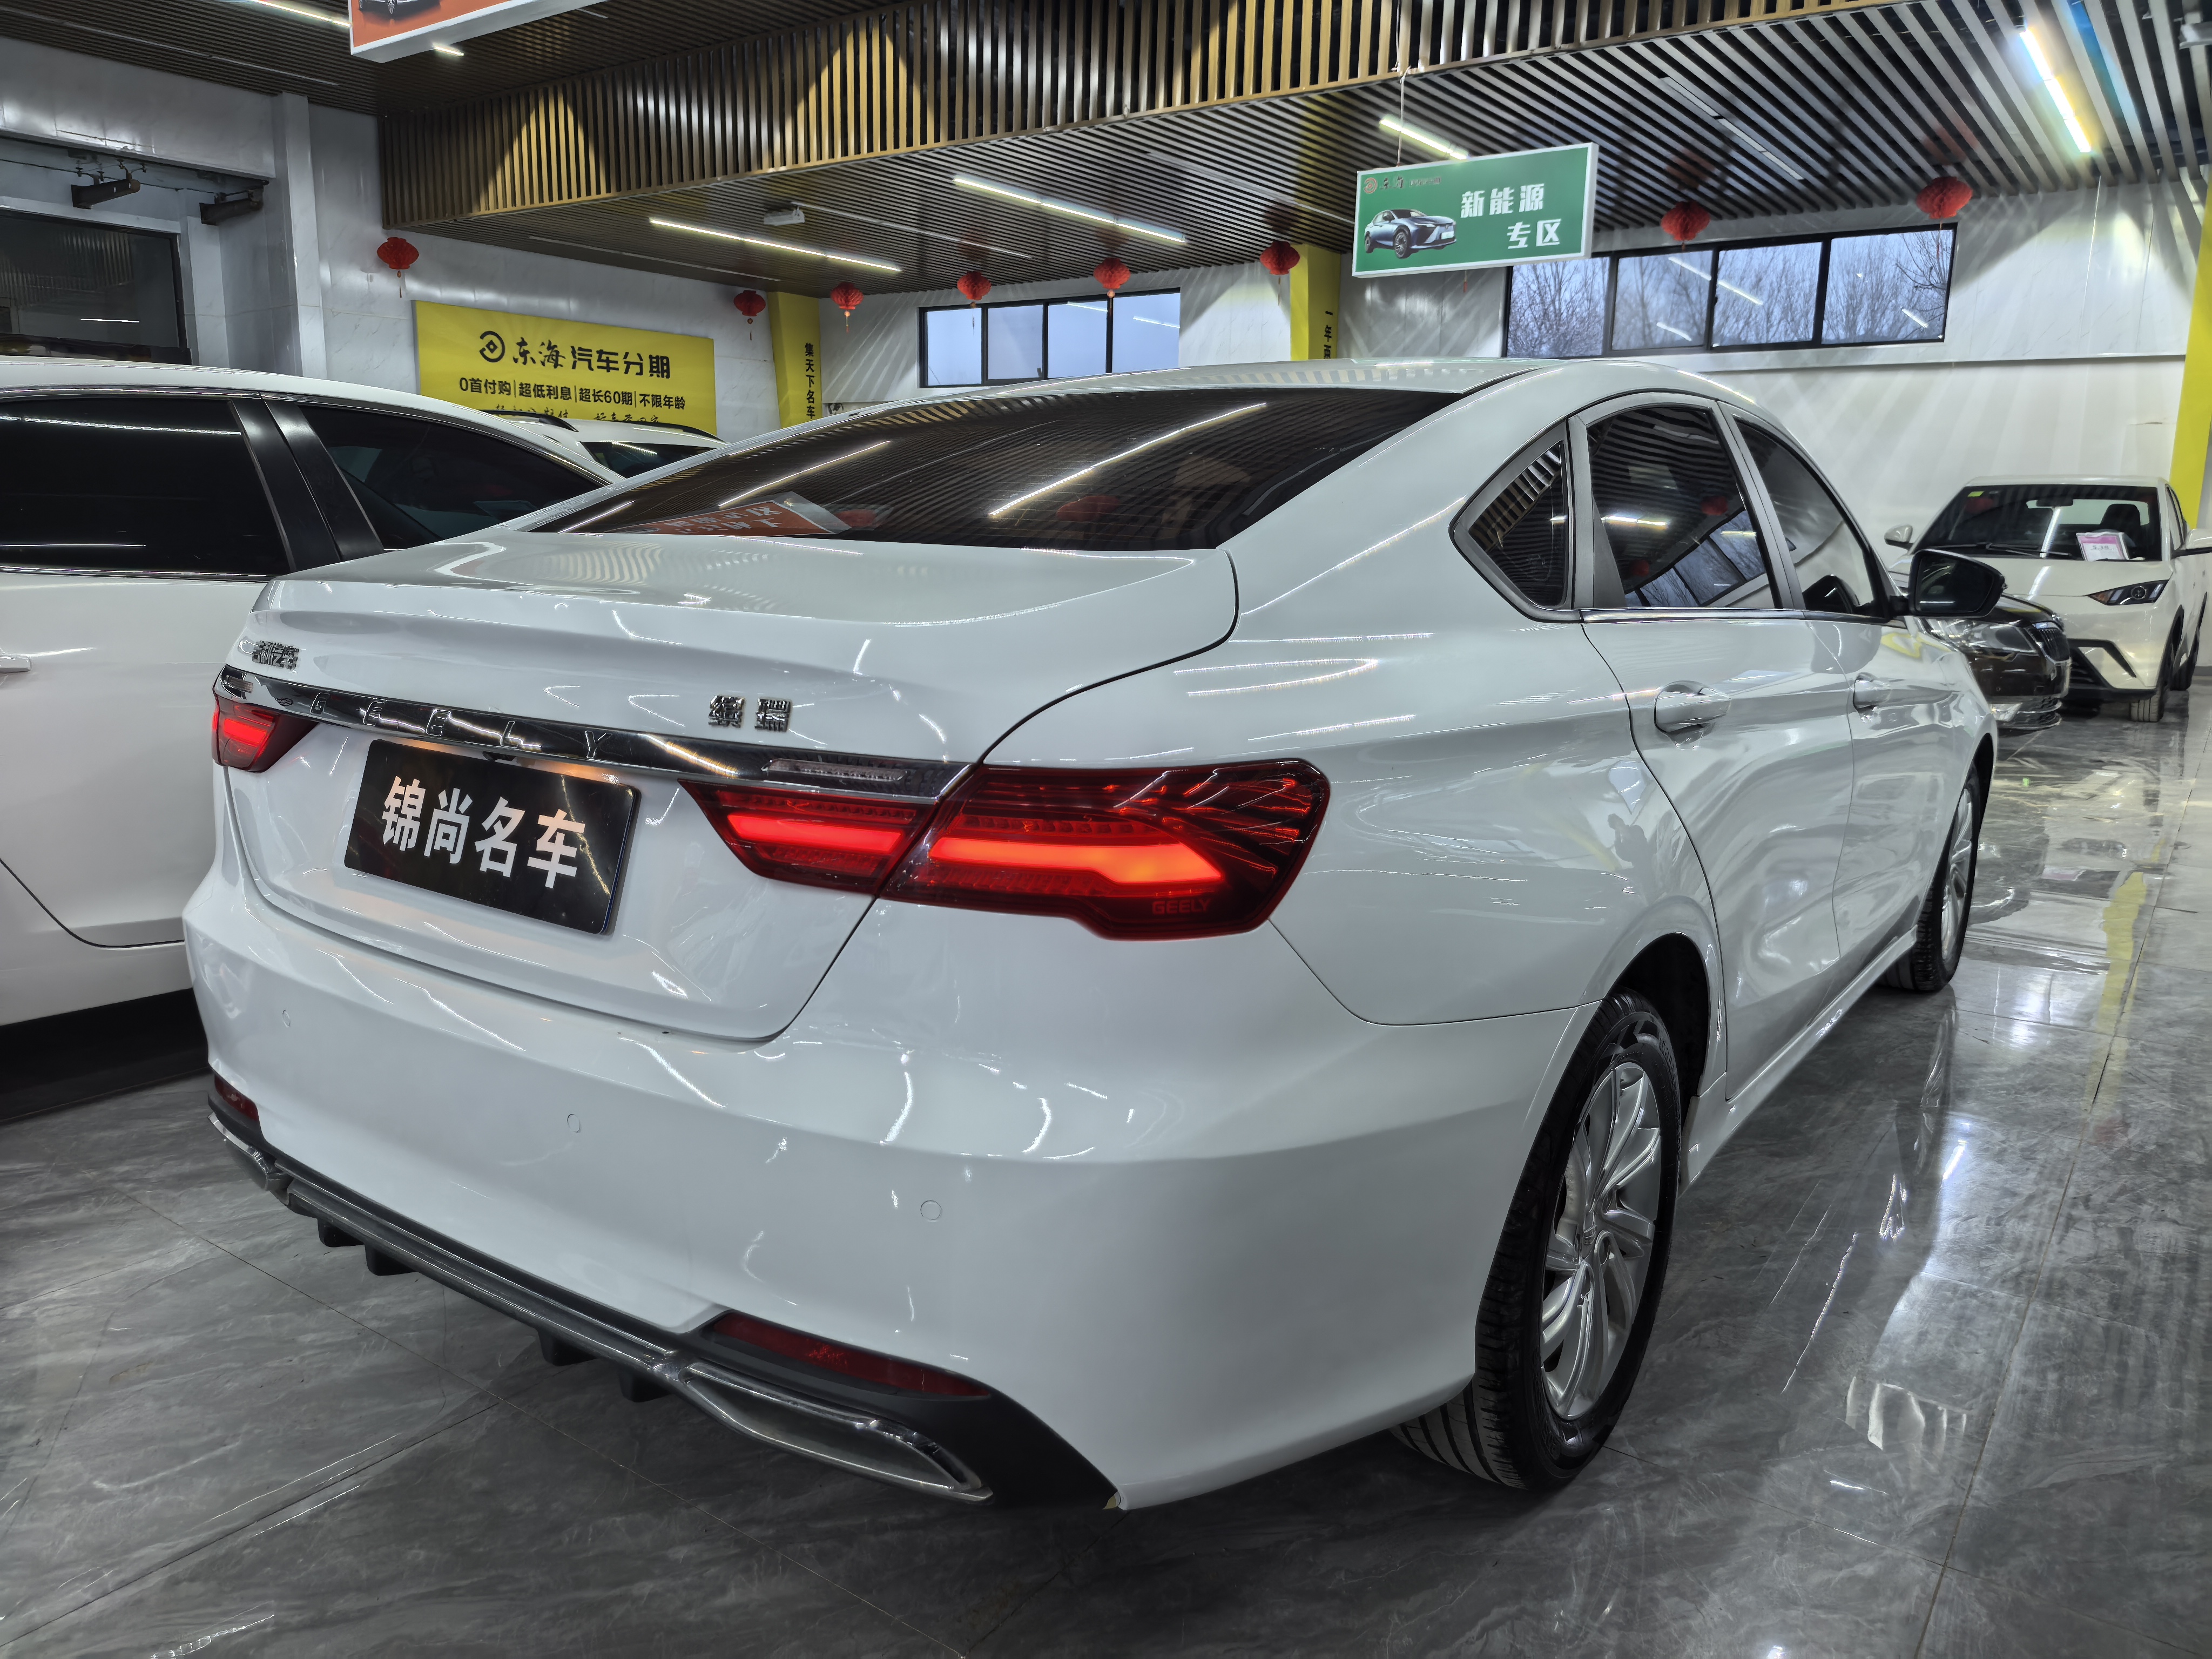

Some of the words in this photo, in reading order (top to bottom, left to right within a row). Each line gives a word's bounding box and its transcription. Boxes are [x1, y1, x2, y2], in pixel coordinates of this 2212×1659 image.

[1460, 184, 1545, 218] 新能源
[1507, 219, 1562, 249] 专区
[518, 382, 572, 400] 超低利息
[579, 388, 633, 406] 超长60期
[639, 393, 686, 410] 不限年龄
[805, 342, 815, 420] 集天下名车
[310, 692, 612, 759] GEELY
[382, 775, 585, 889] 锦尚名车
[1152, 898, 1211, 915] GEELY
